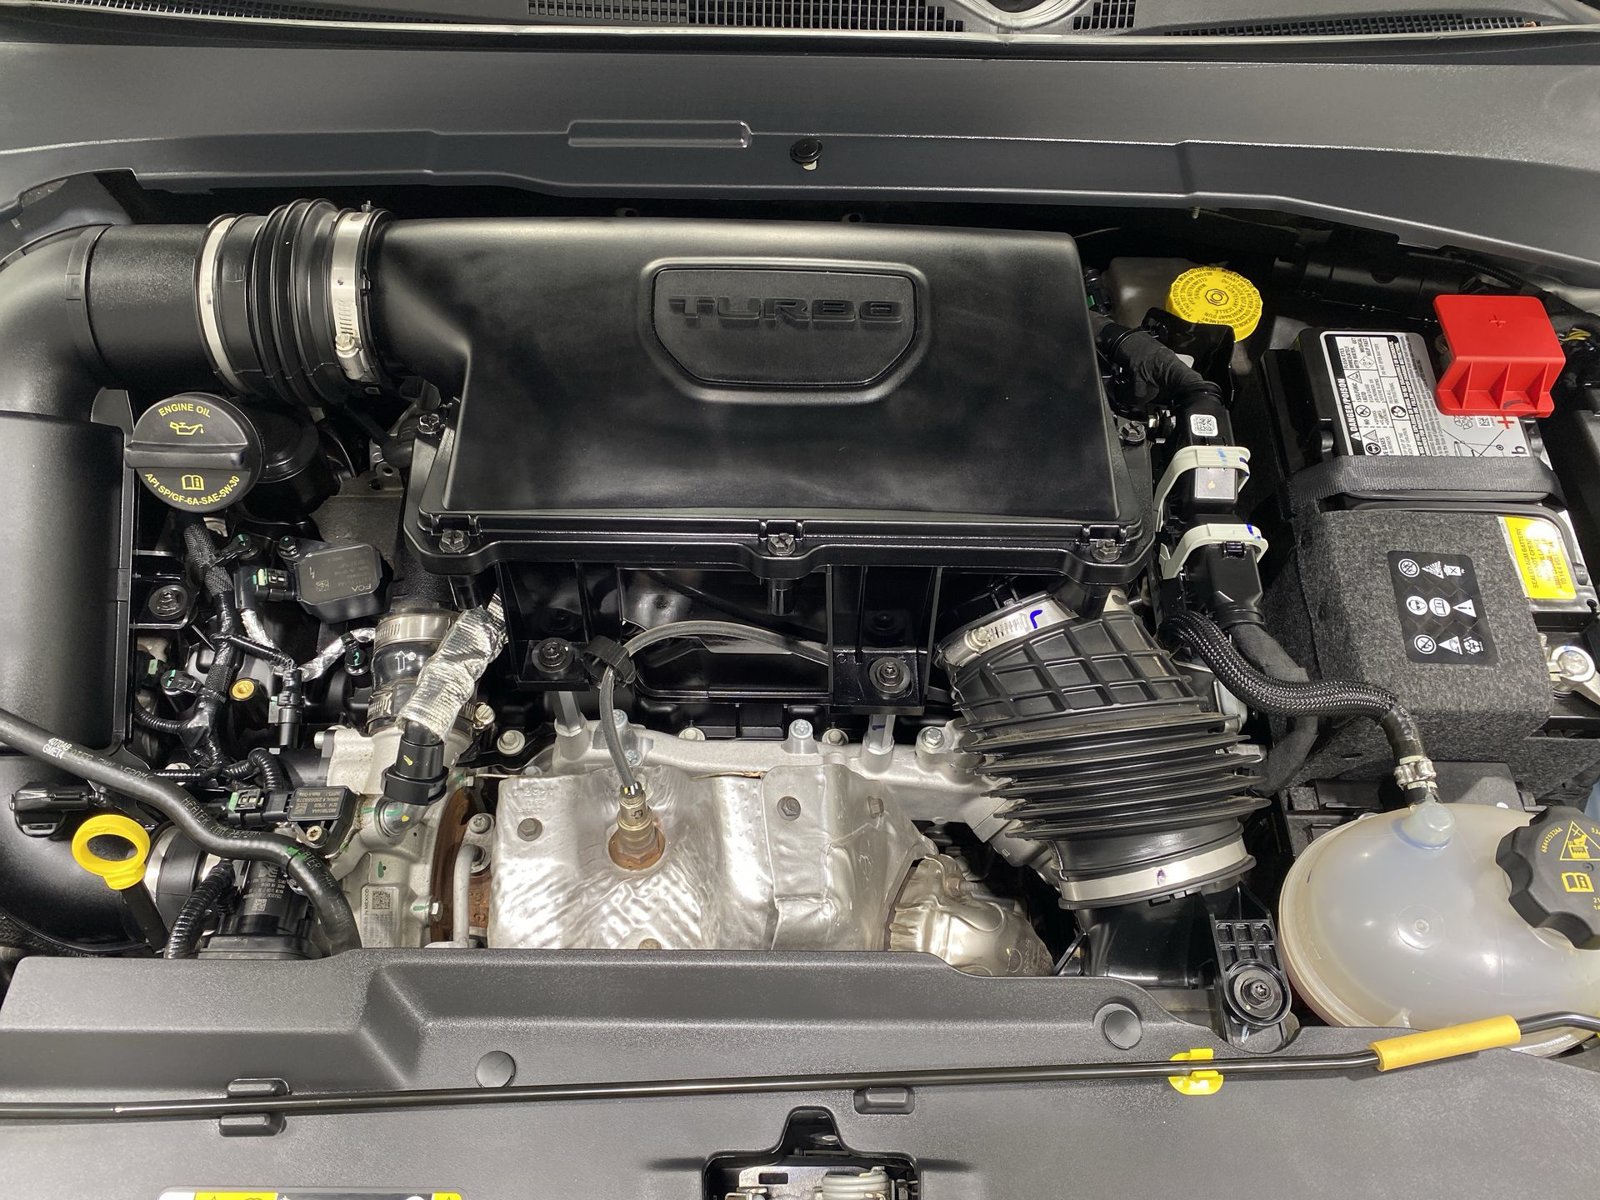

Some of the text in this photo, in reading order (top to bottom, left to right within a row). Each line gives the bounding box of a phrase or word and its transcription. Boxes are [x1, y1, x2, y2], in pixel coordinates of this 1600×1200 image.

[668, 295, 903, 328] TURBO
[158, 403, 211, 418] ENGINE OIL
[1337, 378, 1358, 431] DANGER/POISON
[145, 473, 160, 488] API
[351, 583, 371, 592] FCA
